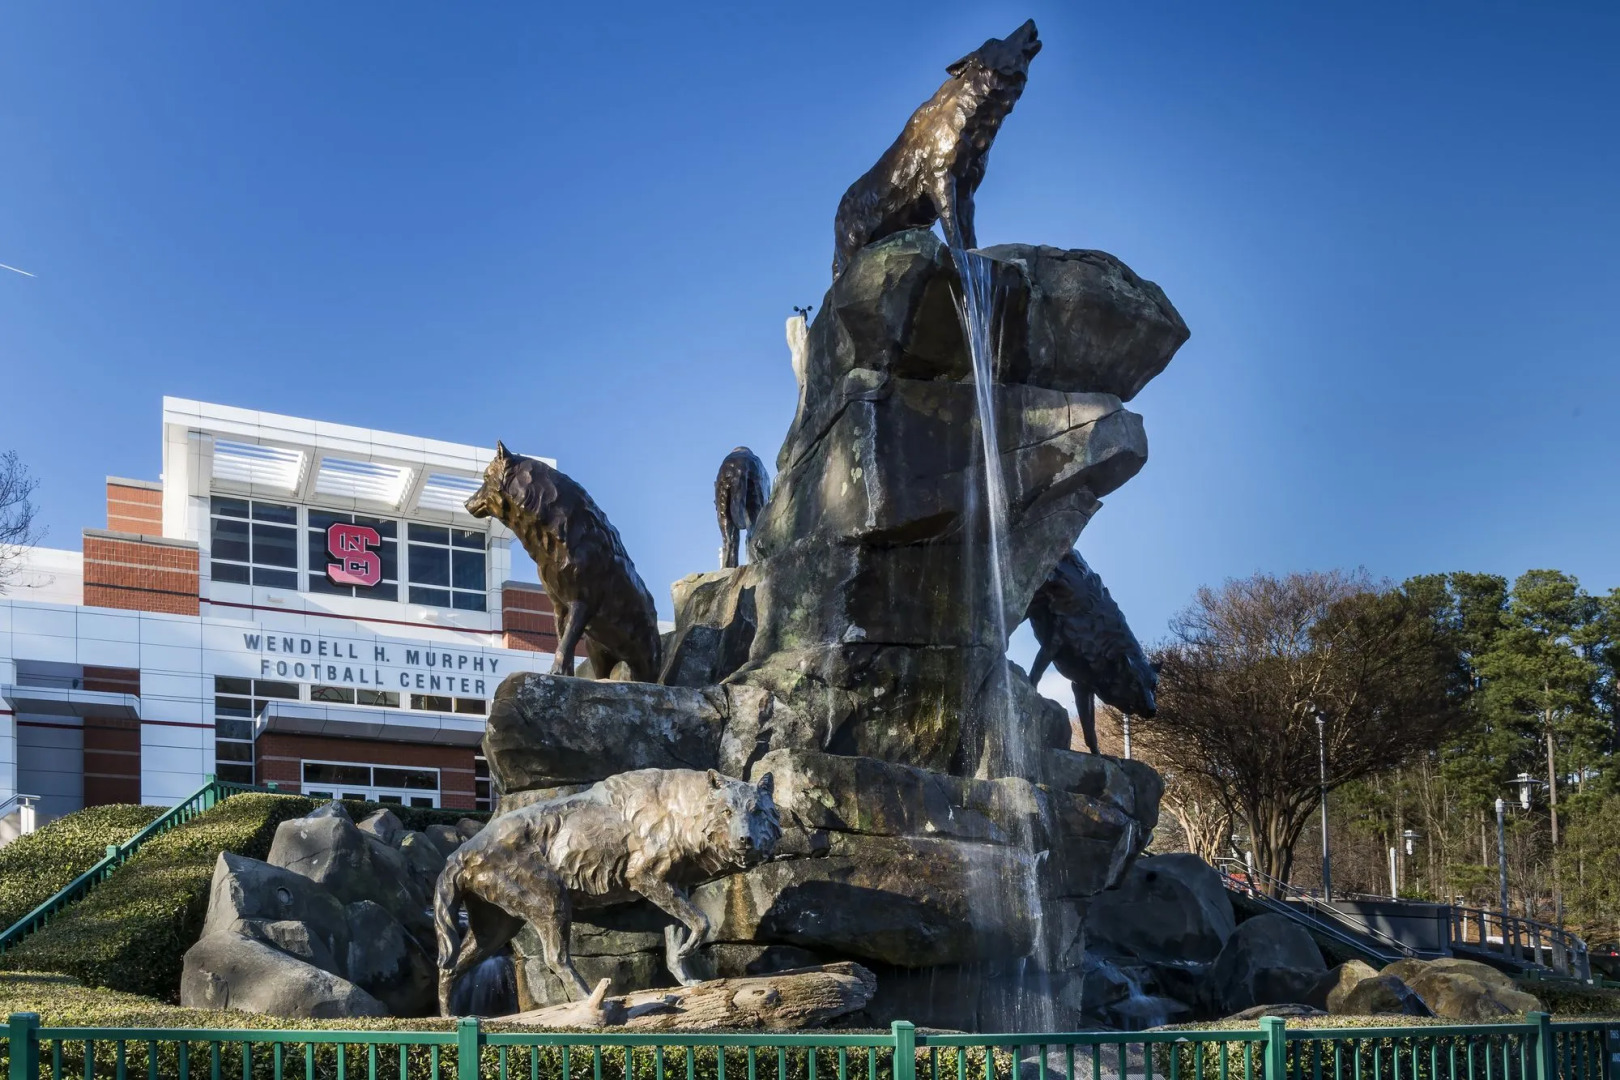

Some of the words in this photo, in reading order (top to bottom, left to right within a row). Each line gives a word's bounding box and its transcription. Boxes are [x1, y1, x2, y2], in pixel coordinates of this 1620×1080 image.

[243, 633, 358, 660] WENDELL
[374, 645, 390, 662] H.
[406, 649, 499, 673] MURPHY
[261, 658, 384, 685] FOOTBALL
[400, 672, 486, 695] CENTER
